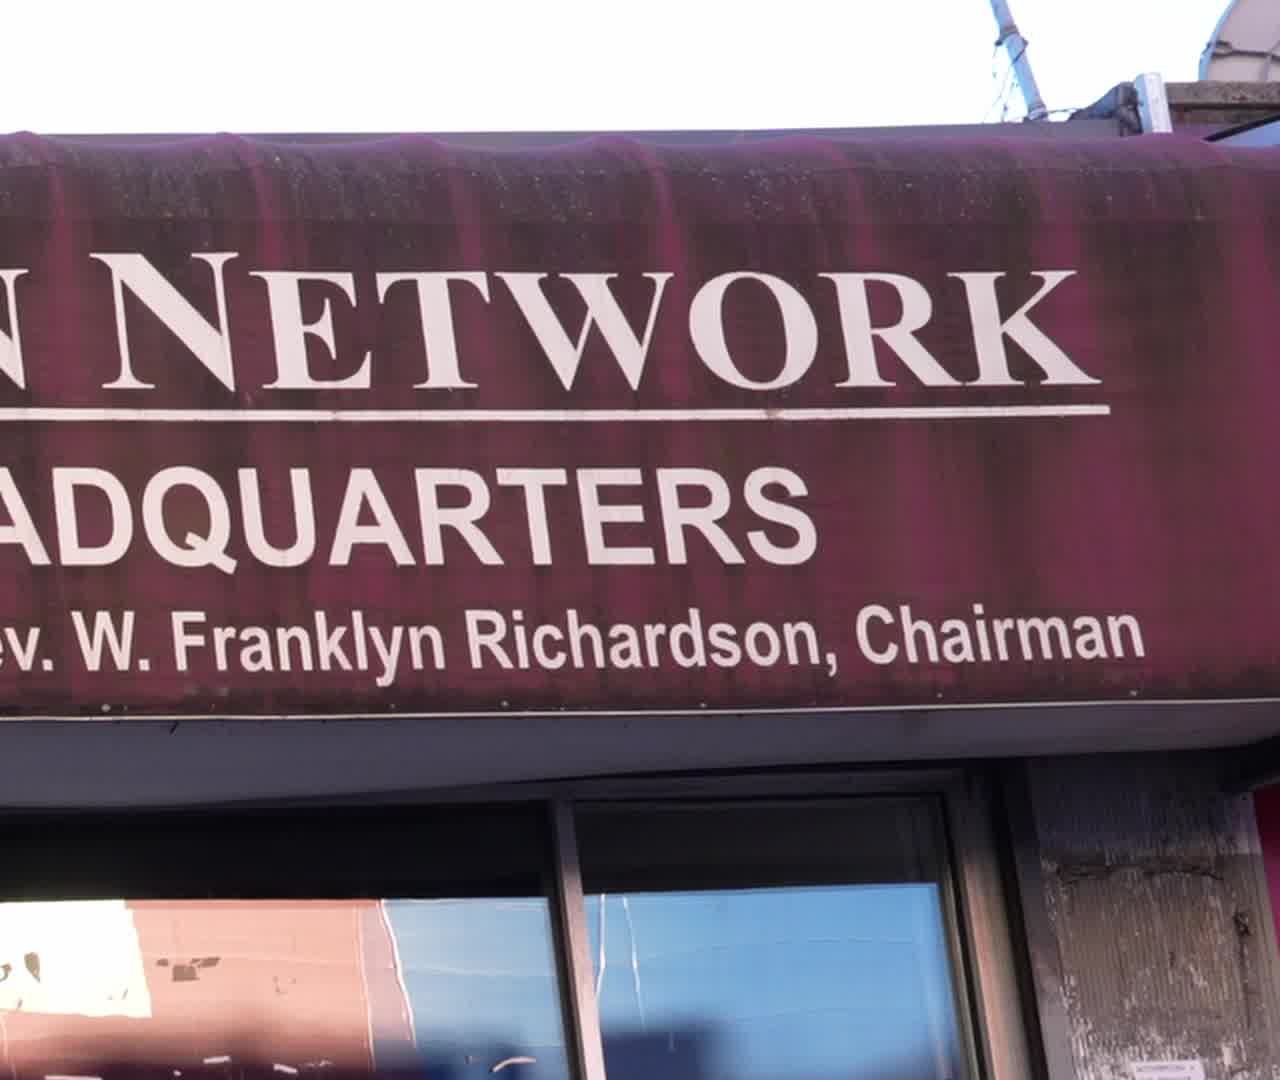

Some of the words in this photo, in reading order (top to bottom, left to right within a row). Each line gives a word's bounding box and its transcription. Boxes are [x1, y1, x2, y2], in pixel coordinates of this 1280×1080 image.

[89, 253, 1102, 392] NETWORK
[71, 610, 150, 671] W.
[171, 609, 445, 687] Franklyn
[465, 607, 838, 677] Richardson,
[856, 603, 1146, 665] Chairman
